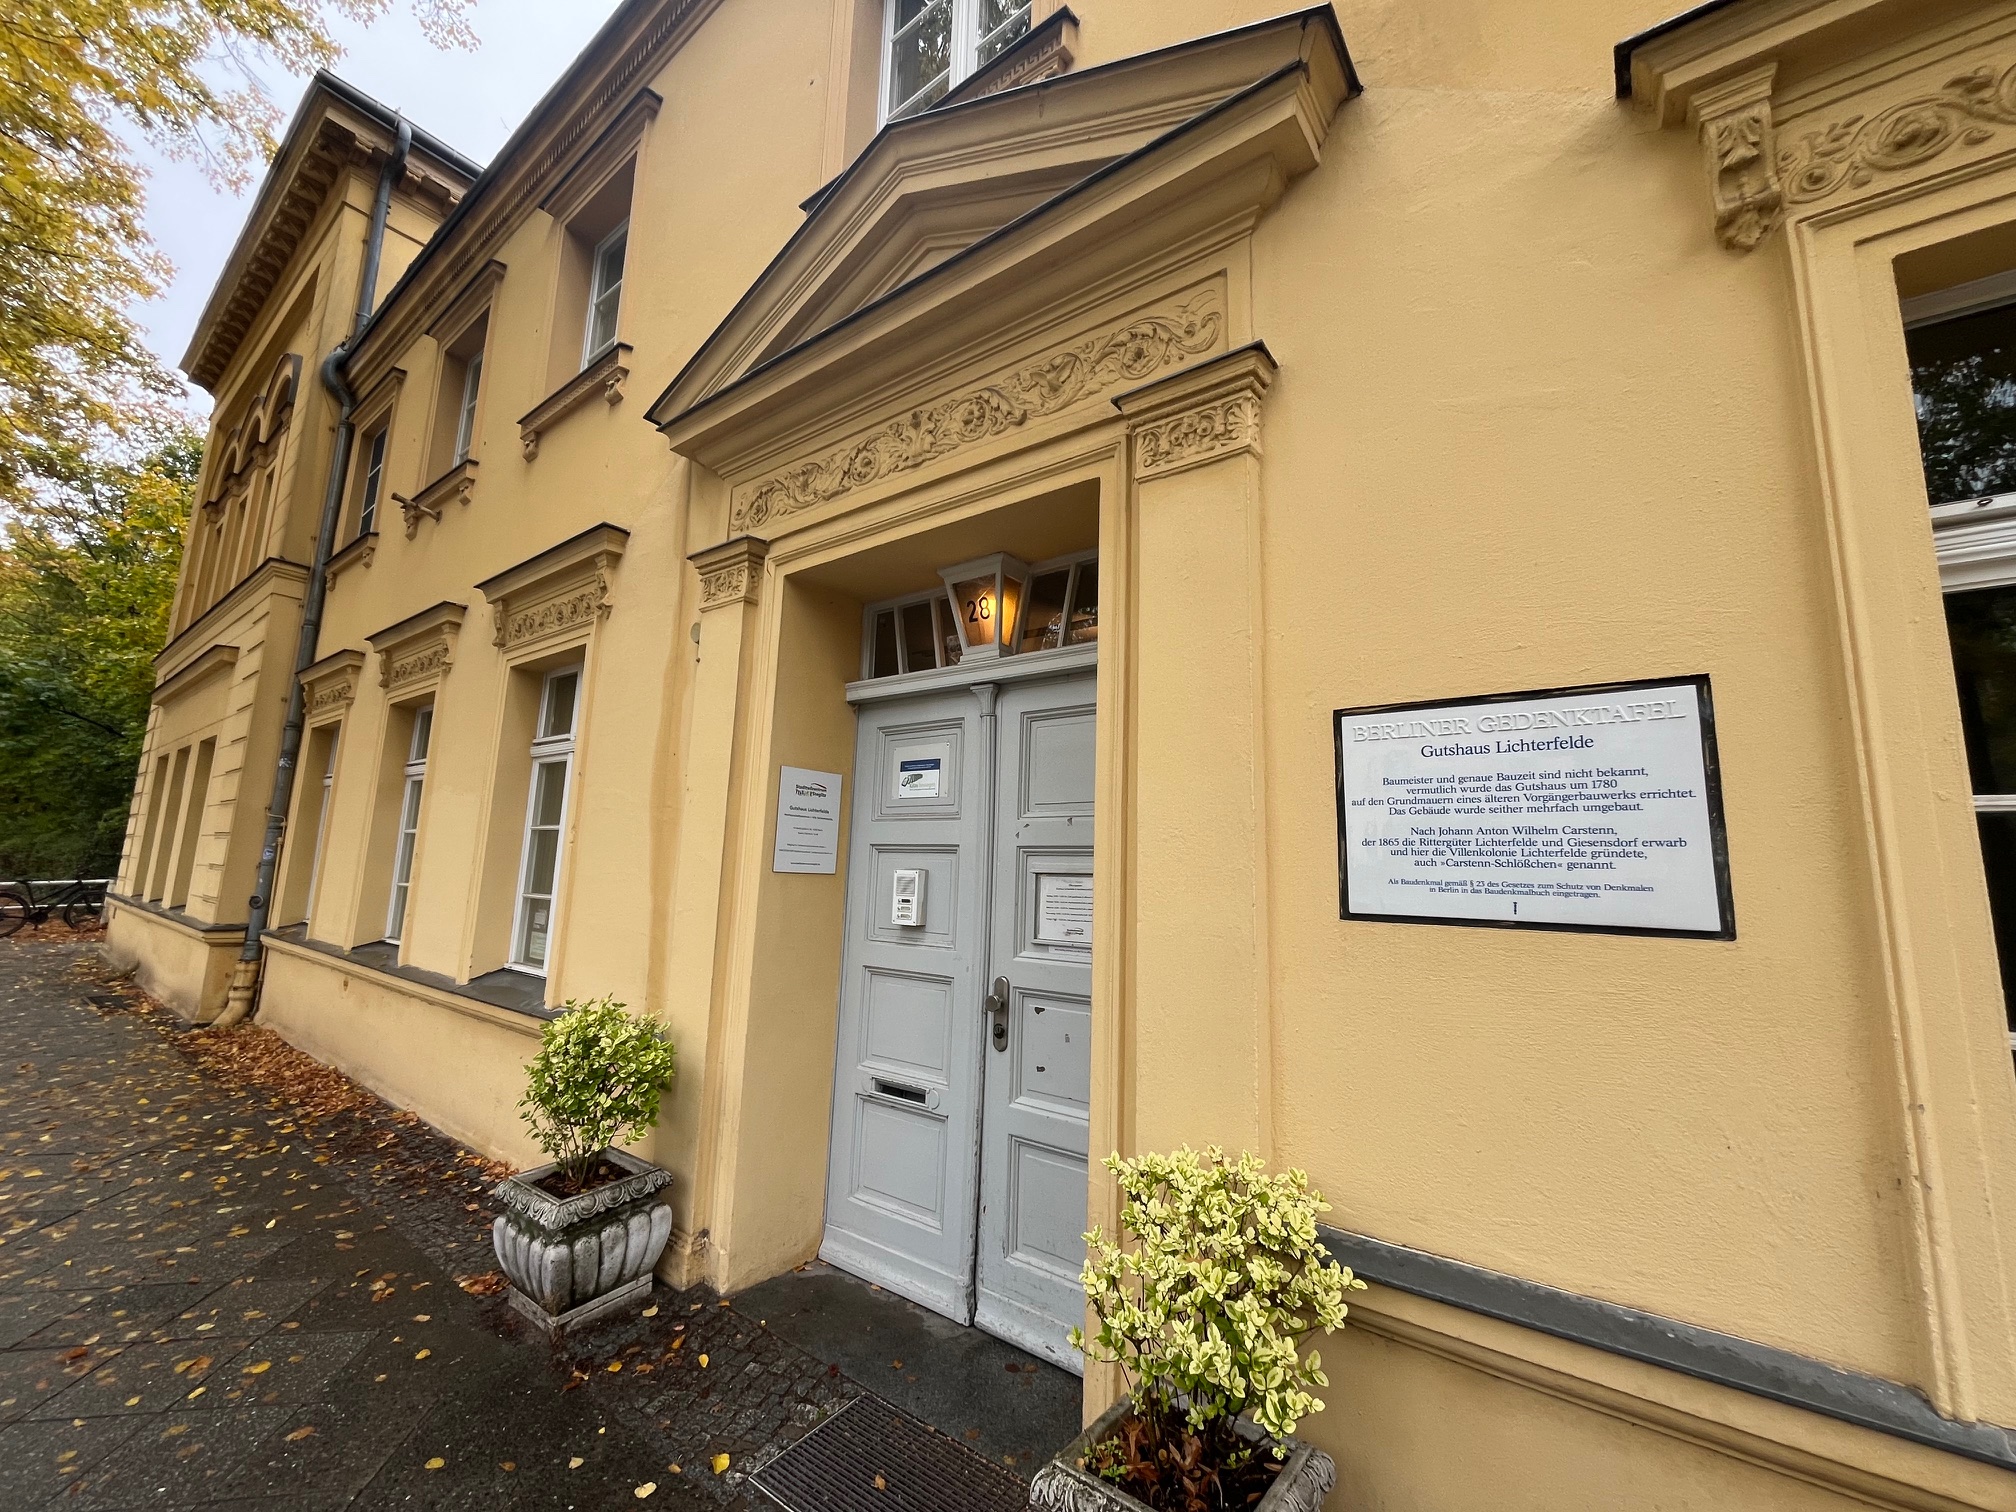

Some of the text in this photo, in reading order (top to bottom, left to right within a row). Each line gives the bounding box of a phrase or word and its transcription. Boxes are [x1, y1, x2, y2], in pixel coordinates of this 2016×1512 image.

[967, 597, 990, 623] 28
[1353, 700, 1687, 742] BERLINER GEDENKTAFEL
[1421, 735, 1594, 758] Gutshaus Lichterfelde
[1383, 767, 1648, 785] Baumeister und genaue Bauzeit sind nicht bekannt,
[1406, 786, 1456, 794] vermutlich
[1460, 784, 1492, 793] wurde
[1495, 783, 1512, 792] das
[1516, 781, 1566, 791] Gutshaus
[1592, 779, 1617, 789] 1780
[1352, 798, 1366, 806] auf
[1368, 797, 1384, 806] den
[1387, 797, 1453, 805] Grundmauern
[1485, 795, 1520, 803] älteren
[1524, 790, 1636, 802] Vorgängerbauwerks
[1640, 789, 1696, 799] errichtet.
[1389, 807, 1406, 815] Das
[1409, 806, 1451, 815] Gebäude
[1454, 806, 1485, 814] wurde
[1489, 805, 1523, 813] seither
[1527, 804, 1579, 813] mehrfach
[1411, 826, 1617, 837] Nach Johann Anton Wilhelm Carstenn,
[1402, 838, 1416, 846] die
[1420, 839, 1471, 848] Rittergüter
[1476, 838, 1538, 846] Lichterfelde
[1542, 838, 1563, 847] und
[1567, 838, 1638, 847] Giesensdorf
[1642, 838, 1687, 847] erwarb
[1391, 847, 1647, 859] und hier die Villenkolonie Lichterfelde gründete,
[1441, 859, 1562, 868] »Carstenn-Schlößchen«
[1567, 861, 1616, 871] genannt.
[1470, 880, 1474, 888] §
[1501, 881, 1534, 889] Gesetzes
[1604, 884, 1654, 892] Denkmalen
[1485, 888, 1550, 896] Baudenkmalbuch
[1553, 890, 1601, 898] eingetragen.
